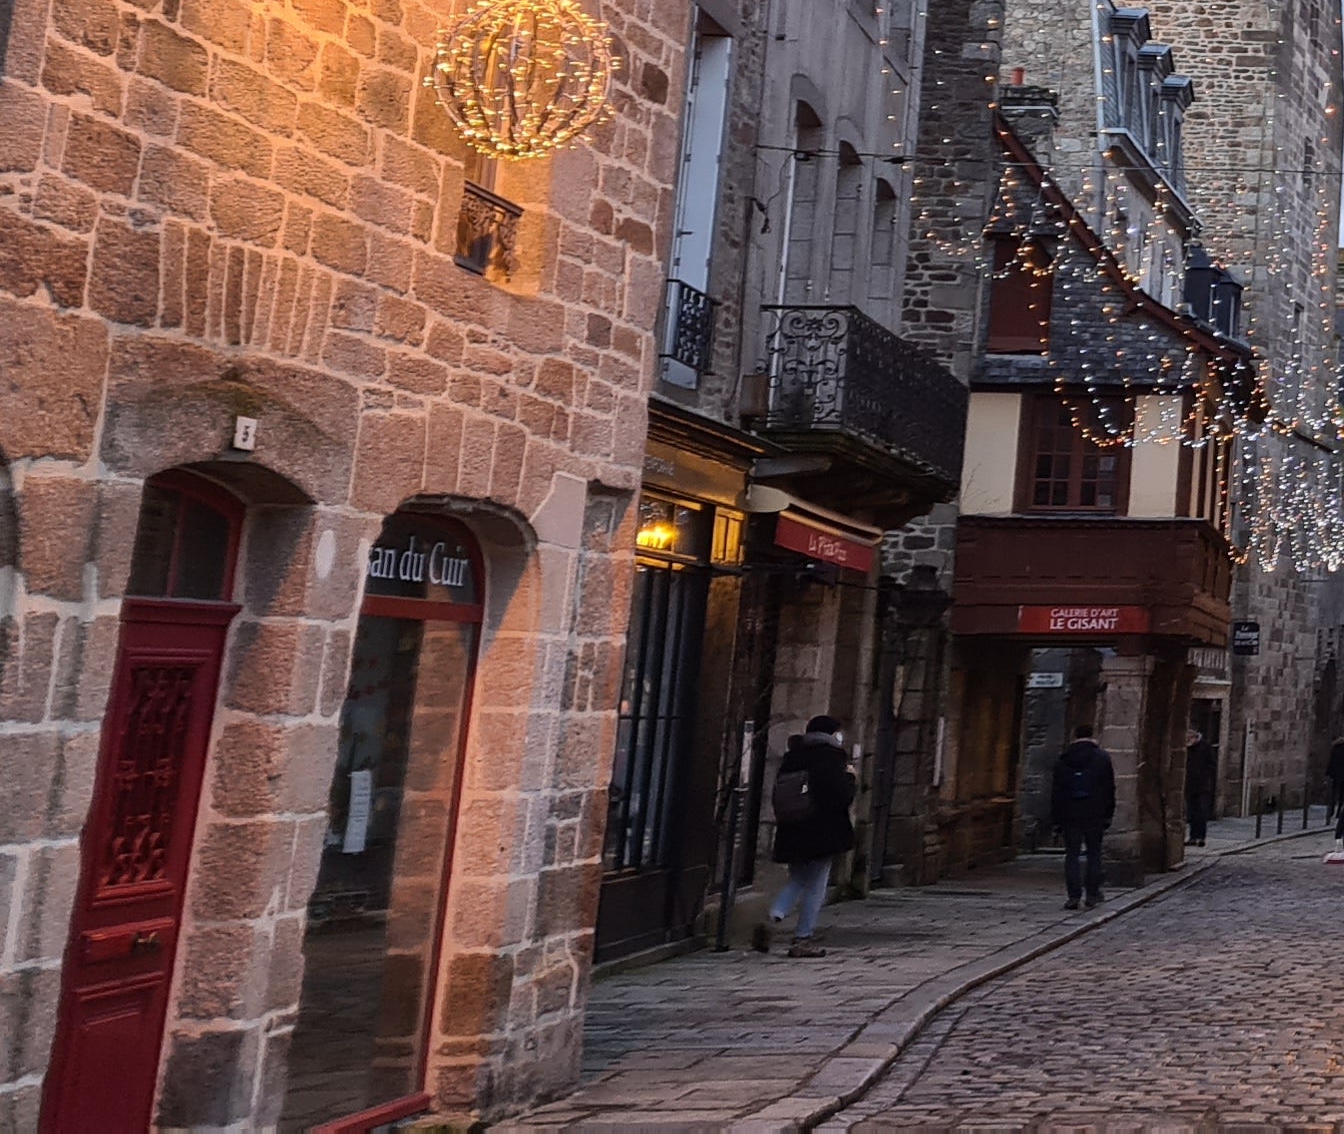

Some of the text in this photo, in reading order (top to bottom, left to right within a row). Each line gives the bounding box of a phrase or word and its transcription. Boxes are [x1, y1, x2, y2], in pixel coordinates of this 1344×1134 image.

[400, 535, 424, 581] du
[429, 542, 468, 586] Cuir
[1050, 608, 1119, 617] GALERIE D'ART
[1050, 618, 1119, 629] LE GISANT
